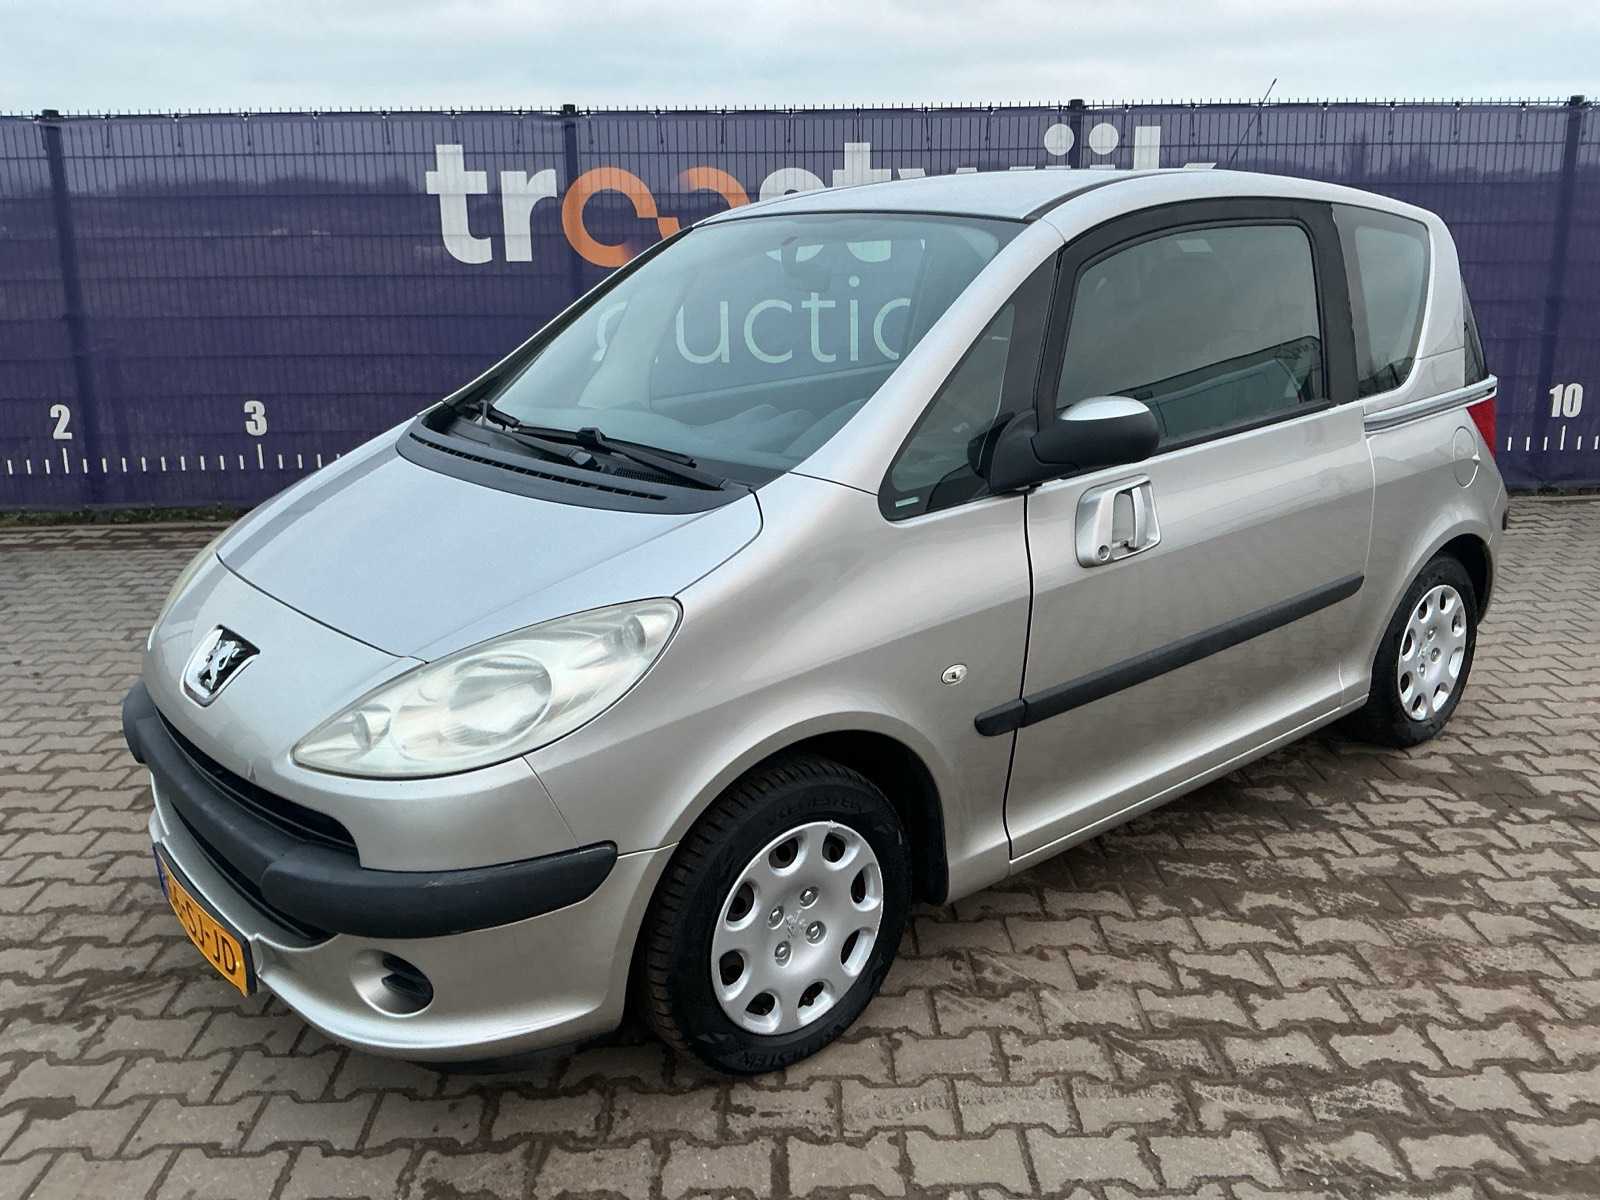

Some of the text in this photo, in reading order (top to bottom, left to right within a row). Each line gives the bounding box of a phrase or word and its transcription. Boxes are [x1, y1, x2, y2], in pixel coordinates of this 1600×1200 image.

[243, 400, 268, 436] 3
[1549, 382, 1584, 418] 10
[49, 404, 73, 440] 2
